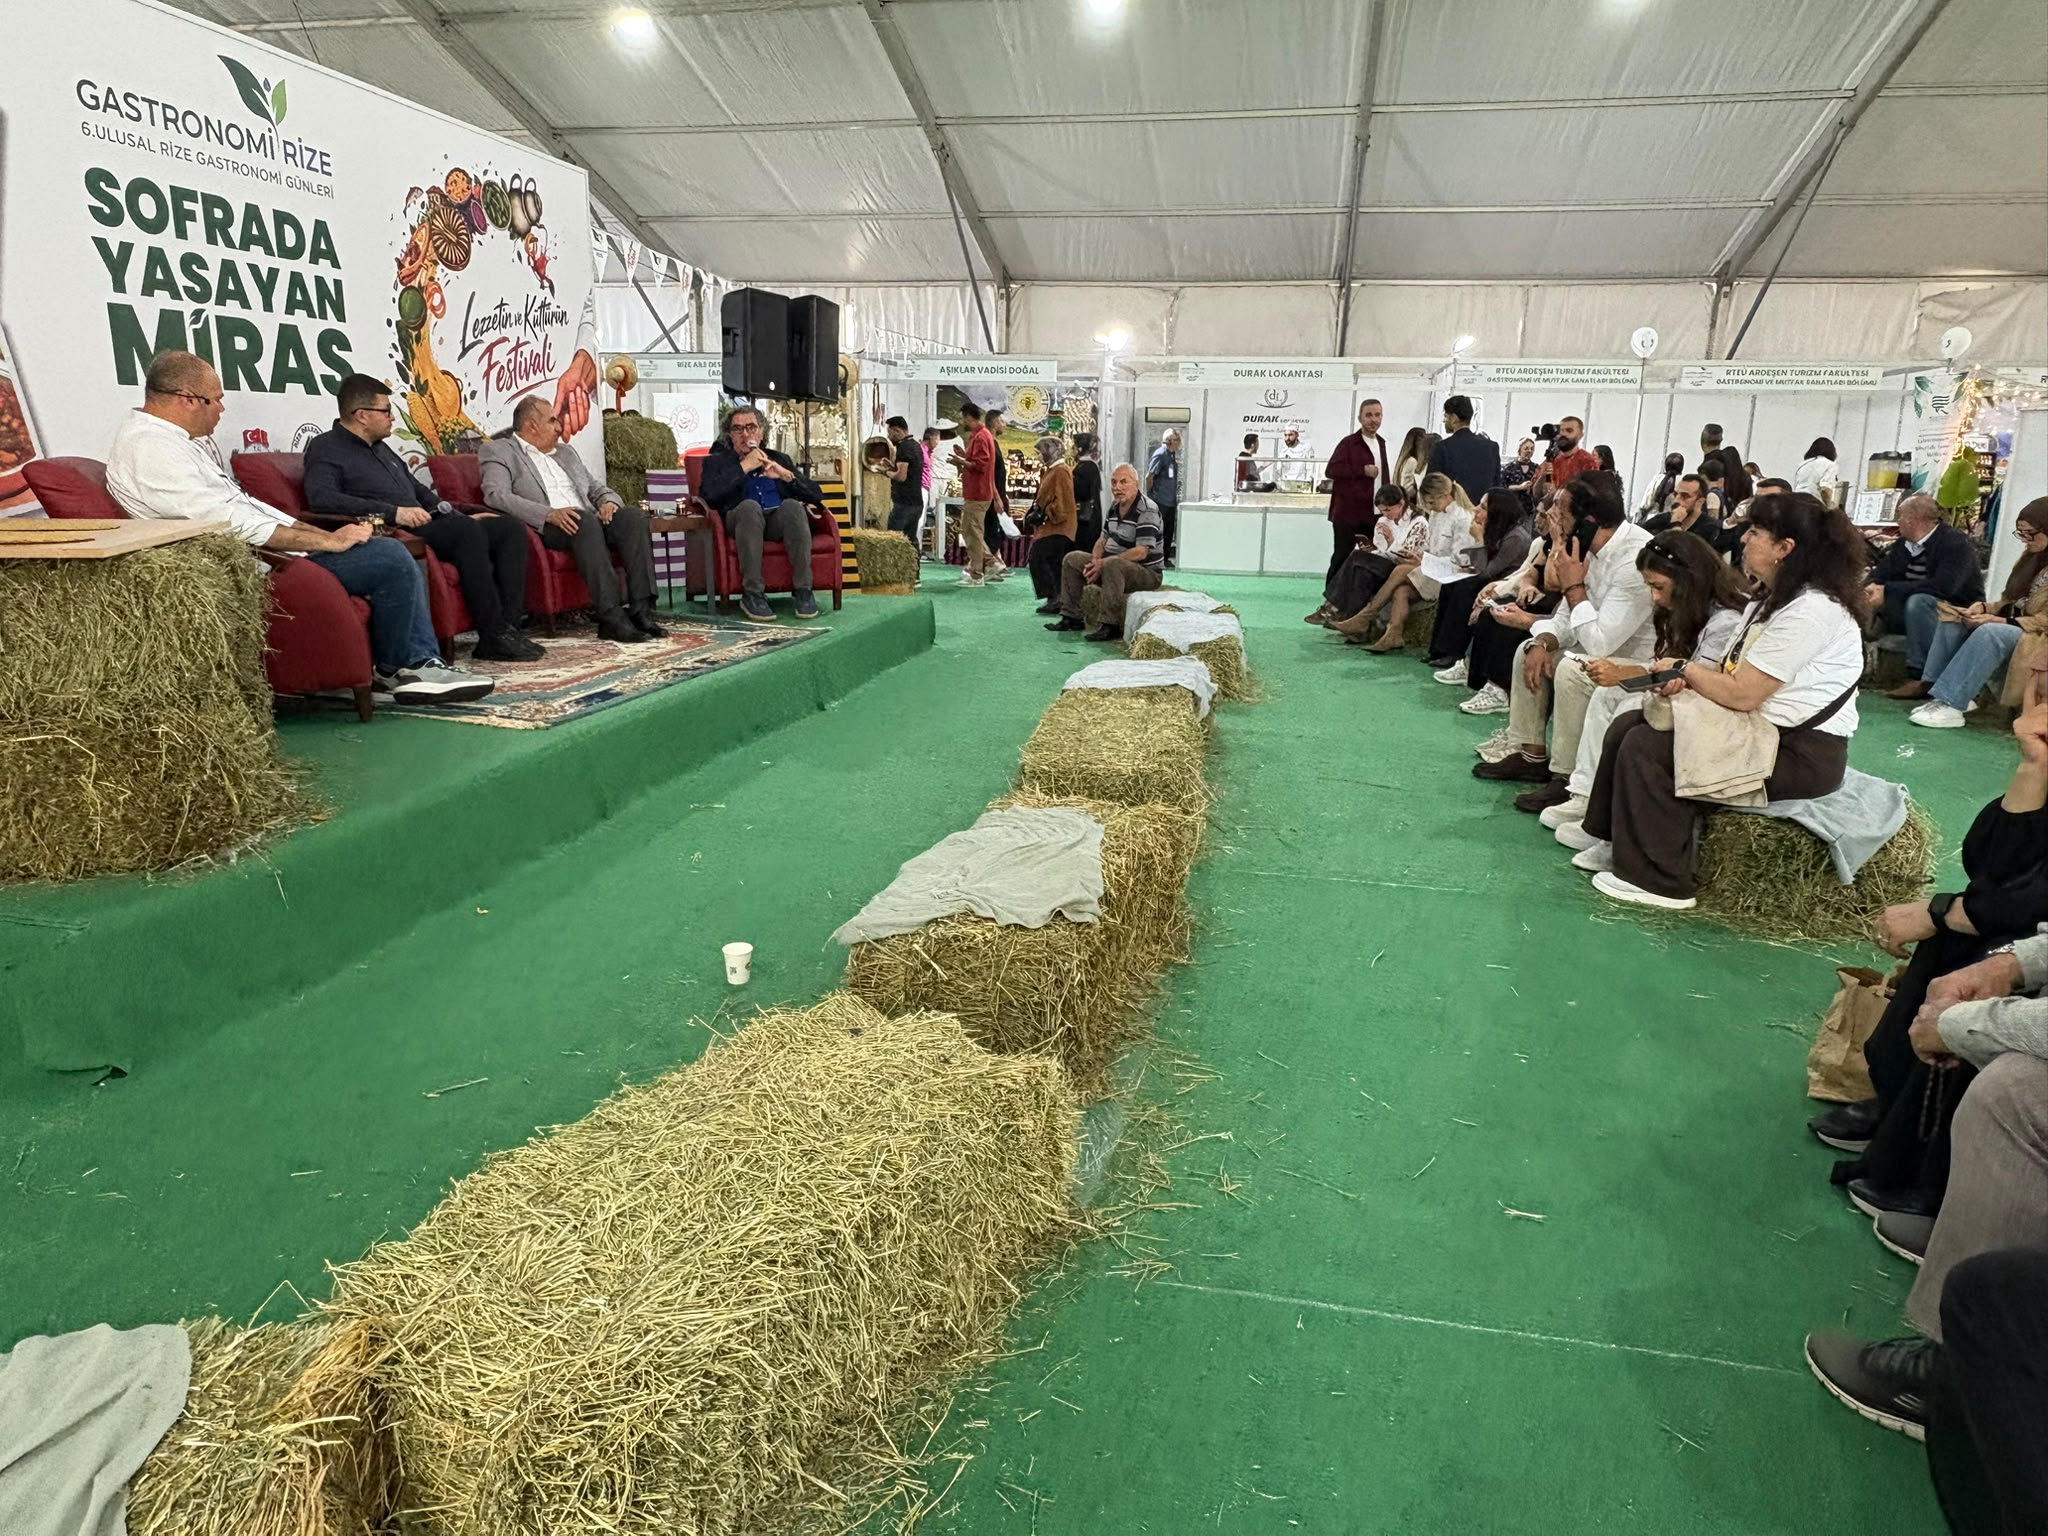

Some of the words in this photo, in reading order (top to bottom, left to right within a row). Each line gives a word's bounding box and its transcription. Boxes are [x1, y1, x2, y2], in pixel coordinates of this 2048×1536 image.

[76, 78, 276, 161] GASTRONOMİ
[282, 137, 333, 177] RİZE
[81, 121, 156, 153] 6.ULUSAL
[160, 140, 193, 162] RİZE
[195, 151, 283, 186] GASTRONOMİ
[285, 176, 335, 200] GÜNLERİ
[84, 167, 342, 270] SOFRADA
[91, 235, 347, 323] YASAYAN
[107, 301, 355, 398] MİRAS
[457, 290, 514, 363] Lezzetin
[477, 333, 558, 405] Festivali
[939, 366, 976, 376] AŞIKLAR
[977, 365, 1007, 375] VADİSİ
[1008, 364, 1040, 375] DOĞAL
[1233, 369, 1266, 378] DURAK
[1268, 369, 1324, 379] LOKANTASI
[1516, 367, 1554, 376] ARDEŞEN
[1748, 369, 1788, 378] ARDEŞEN
[1242, 415, 1280, 423] DURAK
